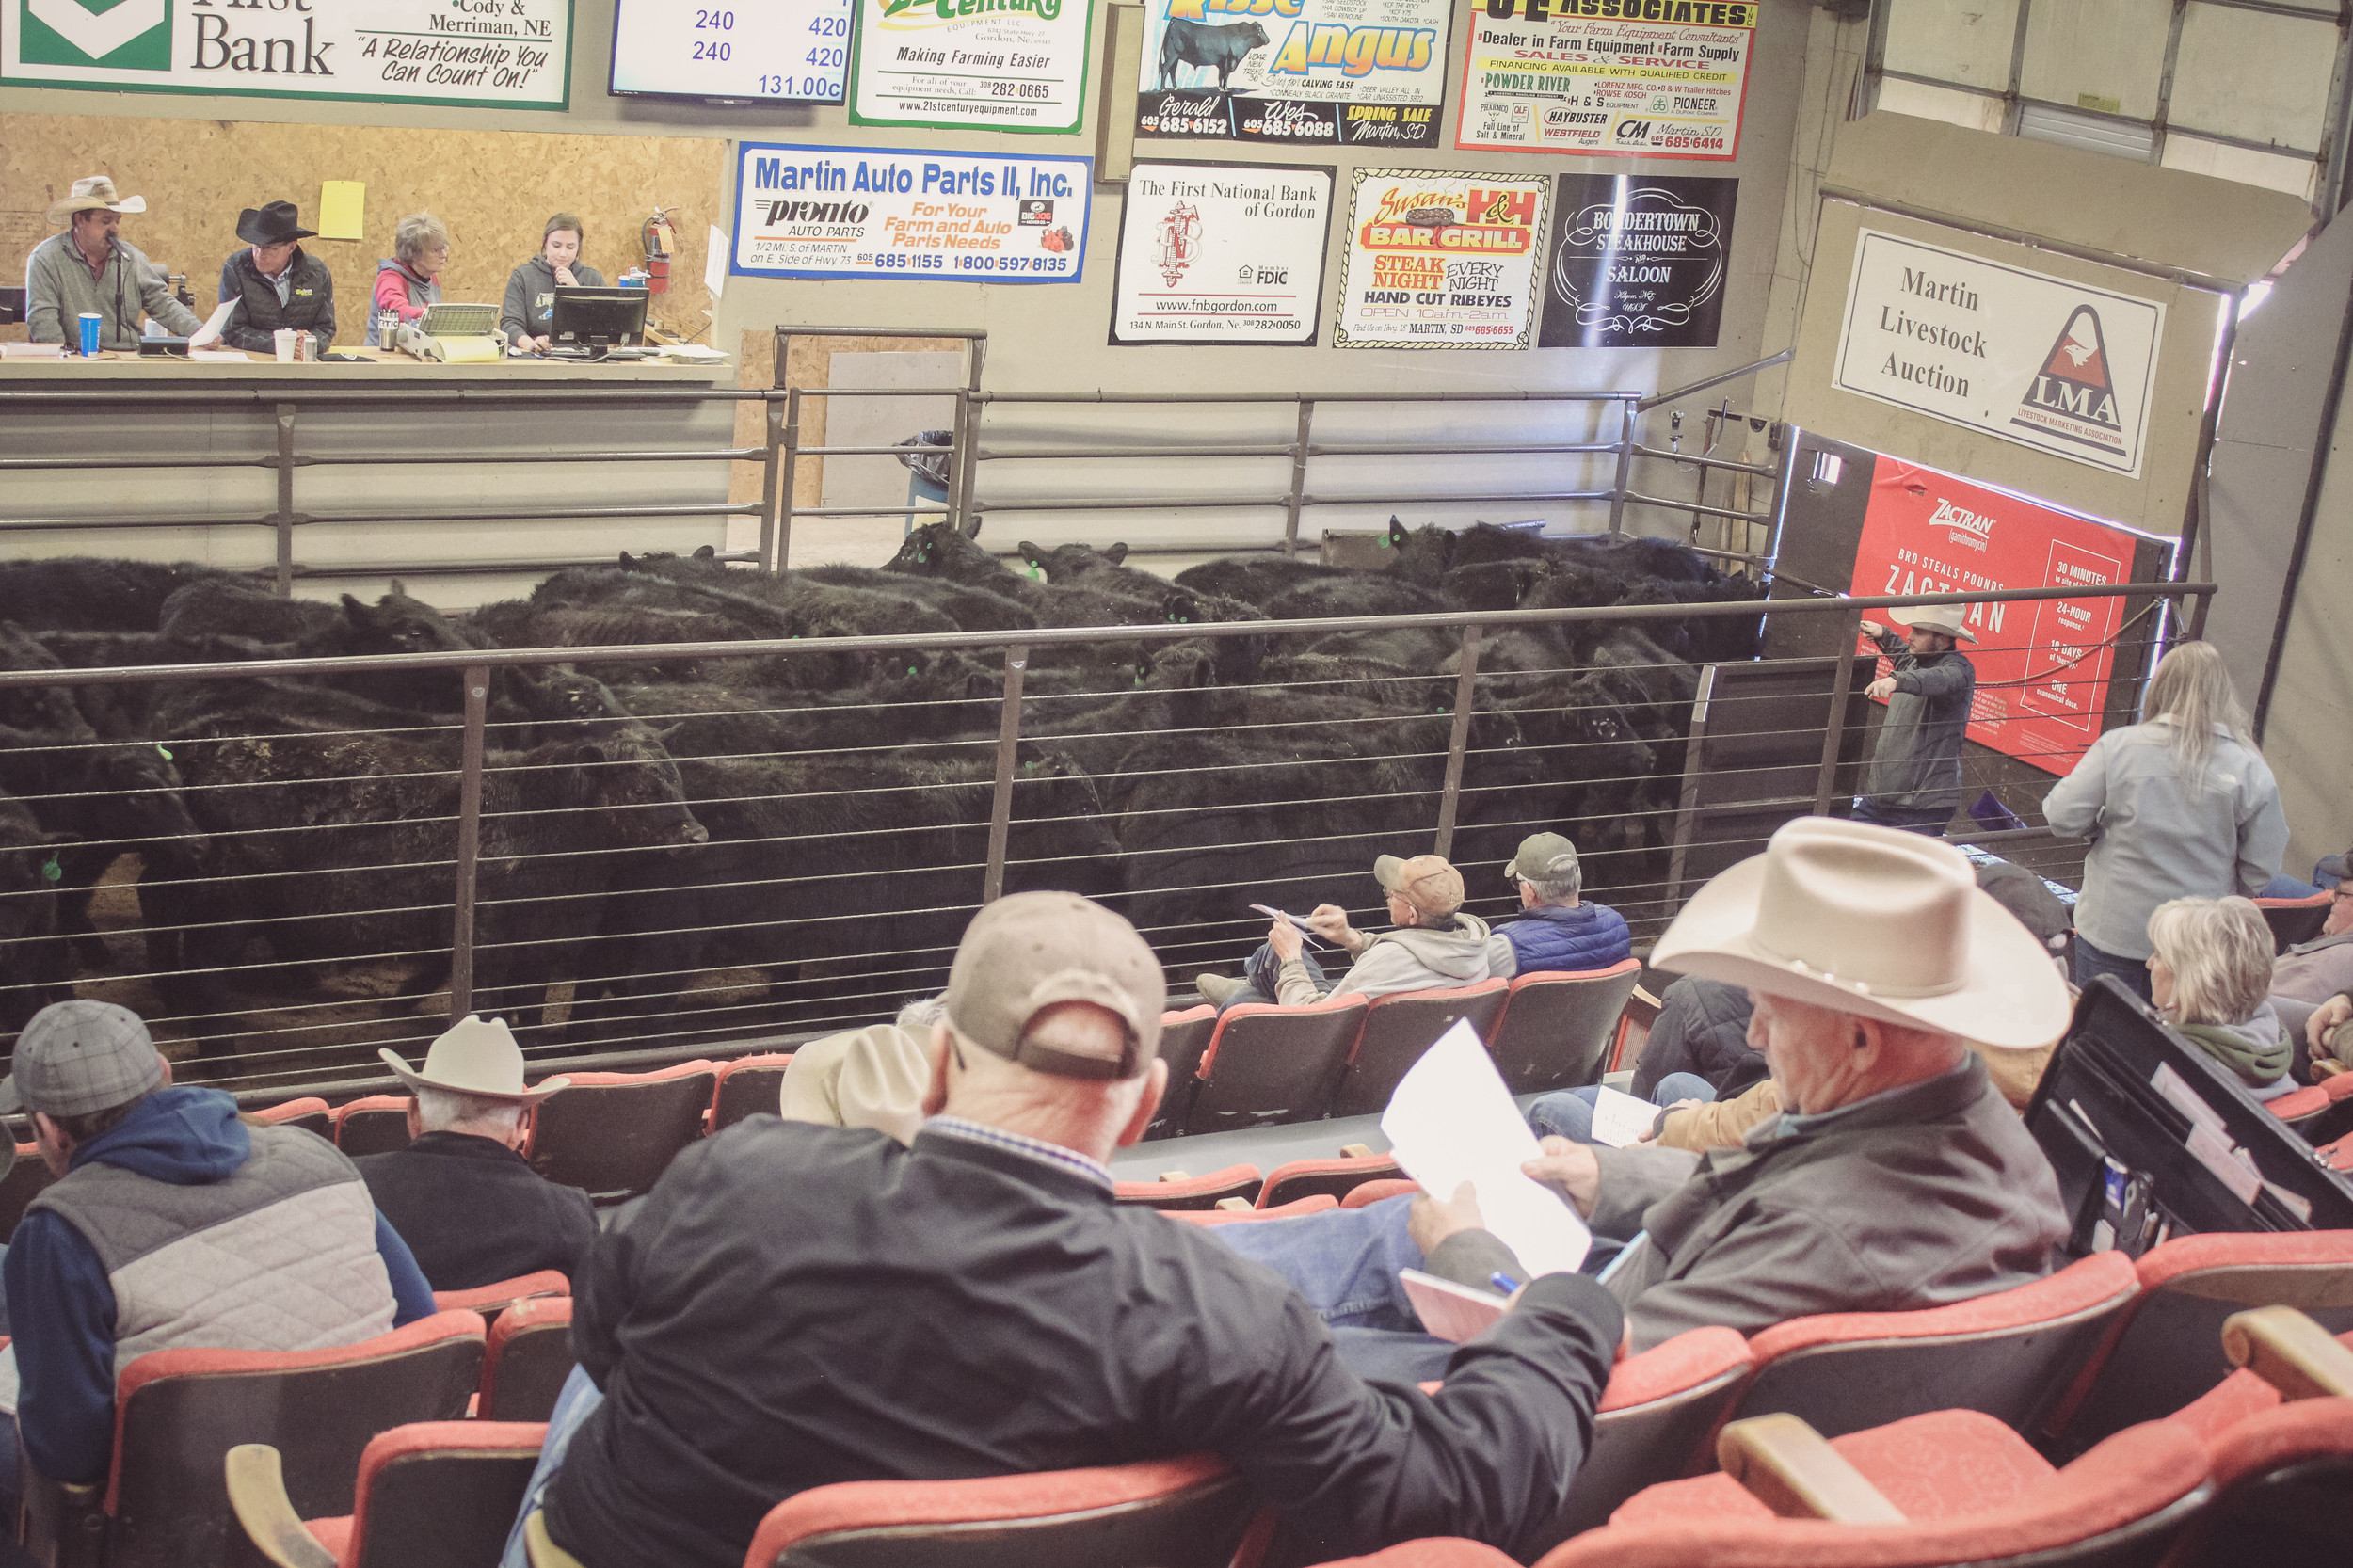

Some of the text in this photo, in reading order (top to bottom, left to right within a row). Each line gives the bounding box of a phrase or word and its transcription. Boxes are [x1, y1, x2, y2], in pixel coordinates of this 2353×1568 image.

[459, 0, 505, 16] Cody
[1560, 0, 1747, 25] ASSOCIATES
[429, 14, 552, 37] Merriman, NE
[696, 9, 734, 30] 240
[809, 17, 847, 37] 420
[947, 19, 1001, 33] EQUIPMENT
[975, 33, 1015, 43] Gordon,
[1581, 22, 1613, 37] Farm
[1616, 24, 1677, 43] Equipment
[190, 12, 336, 75] Bank
[692, 41, 730, 61] 240
[1268, 21, 1437, 78] Angus
[1482, 30, 1739, 62] Dealer in Farm Equipment Farm Supply
[383, 38, 514, 69] Relationship
[515, 47, 549, 69] You
[806, 48, 844, 67] 420
[896, 46, 1051, 69] Making Farming Easier
[1513, 49, 1710, 70] SALES & SERVICE
[381, 61, 485, 86] Can Count
[1490, 59, 1727, 82] FINANCING AVAILABLE WITH QUALIFIED CREDIT
[759, 74, 841, 97] 131.00c
[892, 84, 956, 95] equipment needs,
[1301, 78, 1355, 90] CALVING EASE
[1484, 72, 1571, 92] POWDER RIVER
[1597, 81, 1625, 89] LORENZ
[1626, 83, 1643, 91] MFG.
[1706, 88, 1732, 96] Hitches
[1570, 95, 1579, 106] H
[1583, 96, 1592, 106] &
[1624, 90, 1647, 99] KOSCH
[1673, 96, 1717, 111] PIONEER
[899, 100, 1038, 118] www.21stcenturyequipment.com
[1159, 93, 1221, 117] Gerald
[1263, 100, 1319, 120] Wes
[1346, 104, 1433, 123] SPRING SALE
[1141, 116, 1160, 126] 605
[1243, 119, 1263, 129] 605
[1483, 121, 1511, 132] Full Line
[1548, 111, 1608, 125] HAYBUSTER
[1351, 120, 1400, 142] Martin,
[1476, 130, 1526, 141] Salt Mineral
[1545, 128, 1602, 138] WESTFIELD
[1616, 120, 1651, 139] CM
[1577, 137, 1599, 146] Augers
[755, 156, 848, 192] Martin
[853, 160, 913, 195] Auto
[922, 164, 995, 197] Parts
[1029, 166, 1073, 199] Inc.
[1139, 179, 1318, 201] The First National Bank
[765, 197, 869, 226] pronto
[910, 201, 988, 218] For Your
[1245, 202, 1316, 219] of Gordon
[883, 216, 1013, 235] Farm and Auto
[1592, 211, 1701, 232] BODERTOWN
[788, 225, 865, 238] AUTO PARTS
[1369, 227, 1523, 249] BAR GRILL
[810, 244, 848, 253] MARTIN
[891, 232, 1001, 250] Parts Needs
[1595, 234, 1689, 252] STEAKHOUSE
[750, 253, 852, 265] on Side 73
[856, 252, 873, 262] 605
[1373, 255, 1446, 273] STEAK
[1257, 271, 1289, 285] FDIC
[1446, 261, 1504, 279] EVERY
[1606, 266, 1672, 283] SALOON
[1372, 272, 1444, 290] NIGHT
[1449, 277, 1499, 292] NIGHT
[1899, 265, 1979, 312] Martin
[1156, 298, 1277, 314] www.fnbgordon.com
[1364, 291, 1513, 308] HAND CUT RIBEYES
[1360, 307, 1410, 318] OPEN
[1129, 319, 1241, 330] 134 Main Gordon, Ne.
[1409, 323, 1464, 335] MARTIN, SD
[1878, 305, 1988, 359] Livestock
[1881, 351, 1970, 398] Auction
[2032, 375, 2121, 425] LMA
[2017, 407, 2123, 446] LIVESTOCK MARKETING ASSOCIATION
[1929, 497, 1994, 537] ZACTRAN
[1897, 548, 2005, 592] BRD STEALS POUNDS
[2057, 561, 2069, 575] 30
[2069, 564, 2107, 586] MINUTES
[2057, 600, 2092, 623] 24-HOUR
[2060, 642, 2083, 661] DAYS
[2051, 679, 2068, 695] ONE
[2036, 688, 2065, 706] economical
